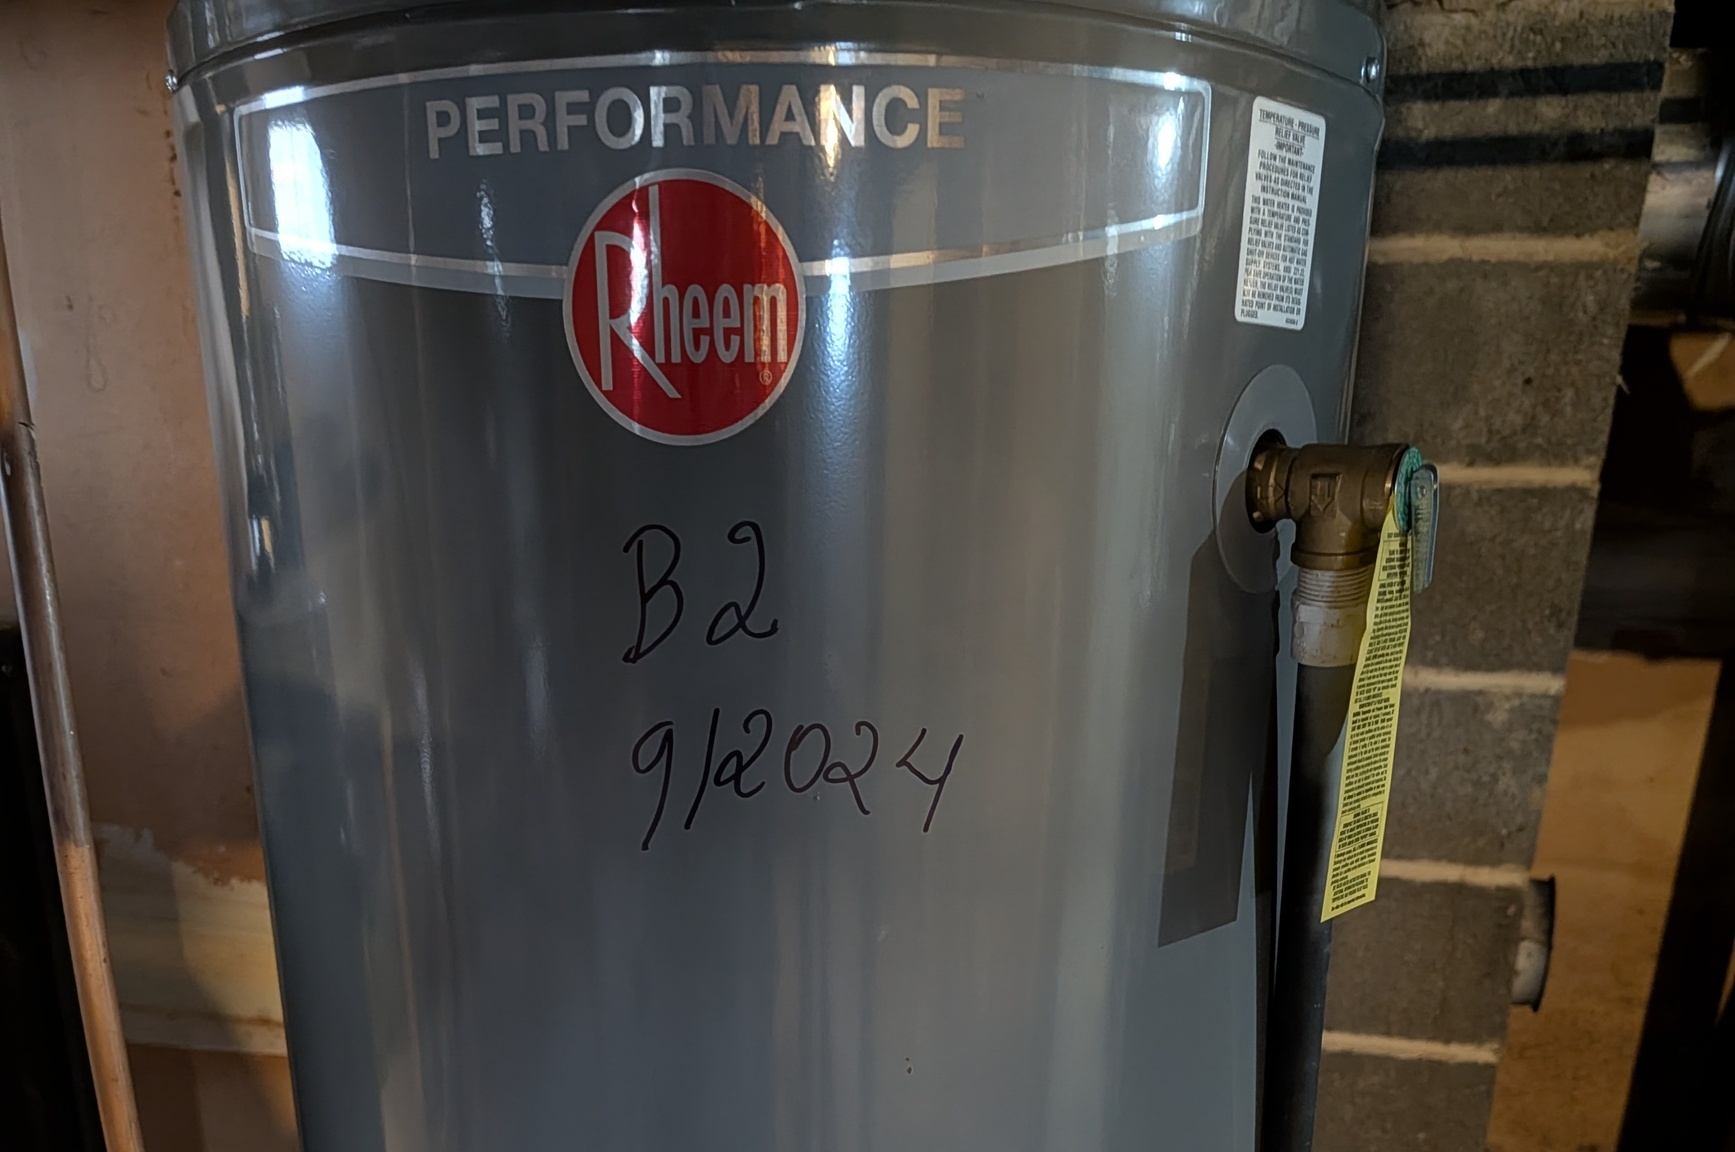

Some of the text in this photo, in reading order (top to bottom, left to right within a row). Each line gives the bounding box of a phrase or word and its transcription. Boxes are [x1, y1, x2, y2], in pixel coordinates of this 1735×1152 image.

[425, 83, 965, 159] PERFORMANCE
[593, 185, 788, 398] Rheem
[632, 707, 964, 851] 9/2024
